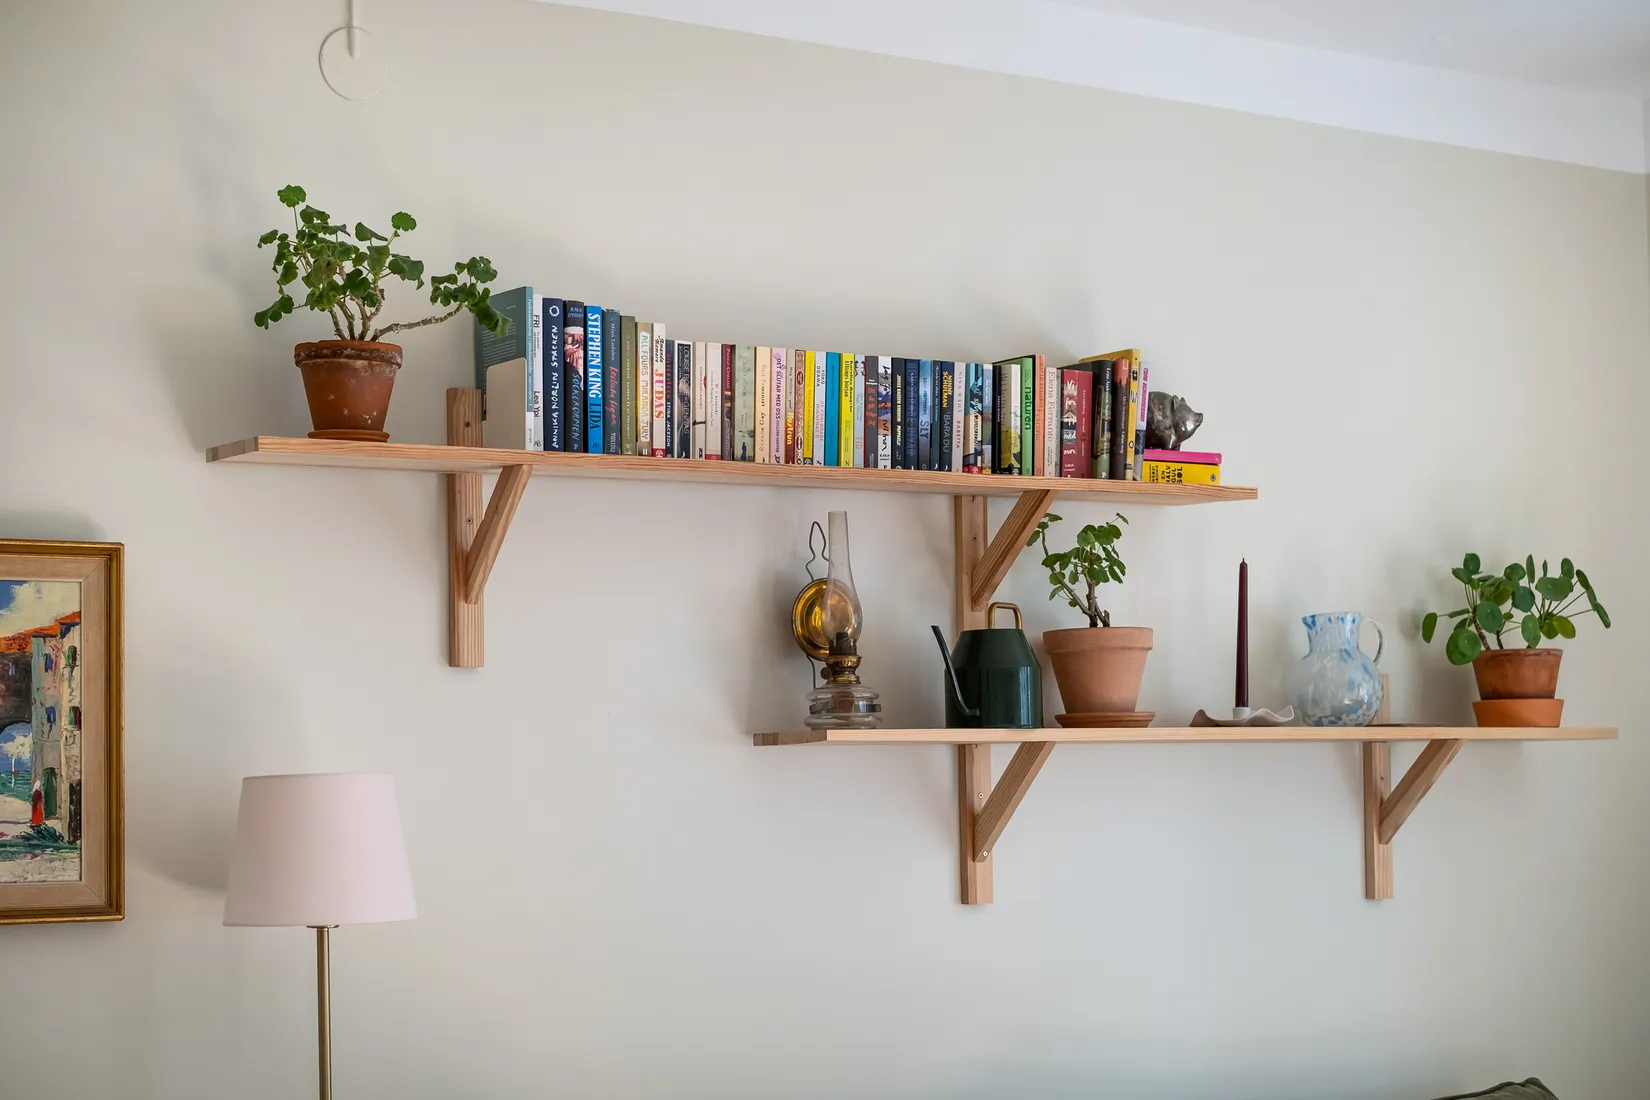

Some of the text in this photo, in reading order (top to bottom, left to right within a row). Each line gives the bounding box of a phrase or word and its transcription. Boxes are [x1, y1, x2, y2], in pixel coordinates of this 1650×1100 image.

[588, 313, 601, 430] STEPHEN KING LIDA
[641, 335, 649, 440] ALL FOURS MIRANDA JULY
[1048, 371, 1056, 398] Elena
[533, 391, 541, 418] Lea Ypi
[572, 373, 581, 440] SOCKERORMEN
[654, 369, 664, 418] JUDAS
[1024, 387, 1032, 430] naturen
[759, 412, 767, 425] Gay
[786, 412, 794, 445] Hustrun
[920, 420, 930, 439] SLY
[1047, 402, 1056, 442] Ferrante
[943, 439, 950, 453] DU
[1161, 470, 1166, 480] EN
